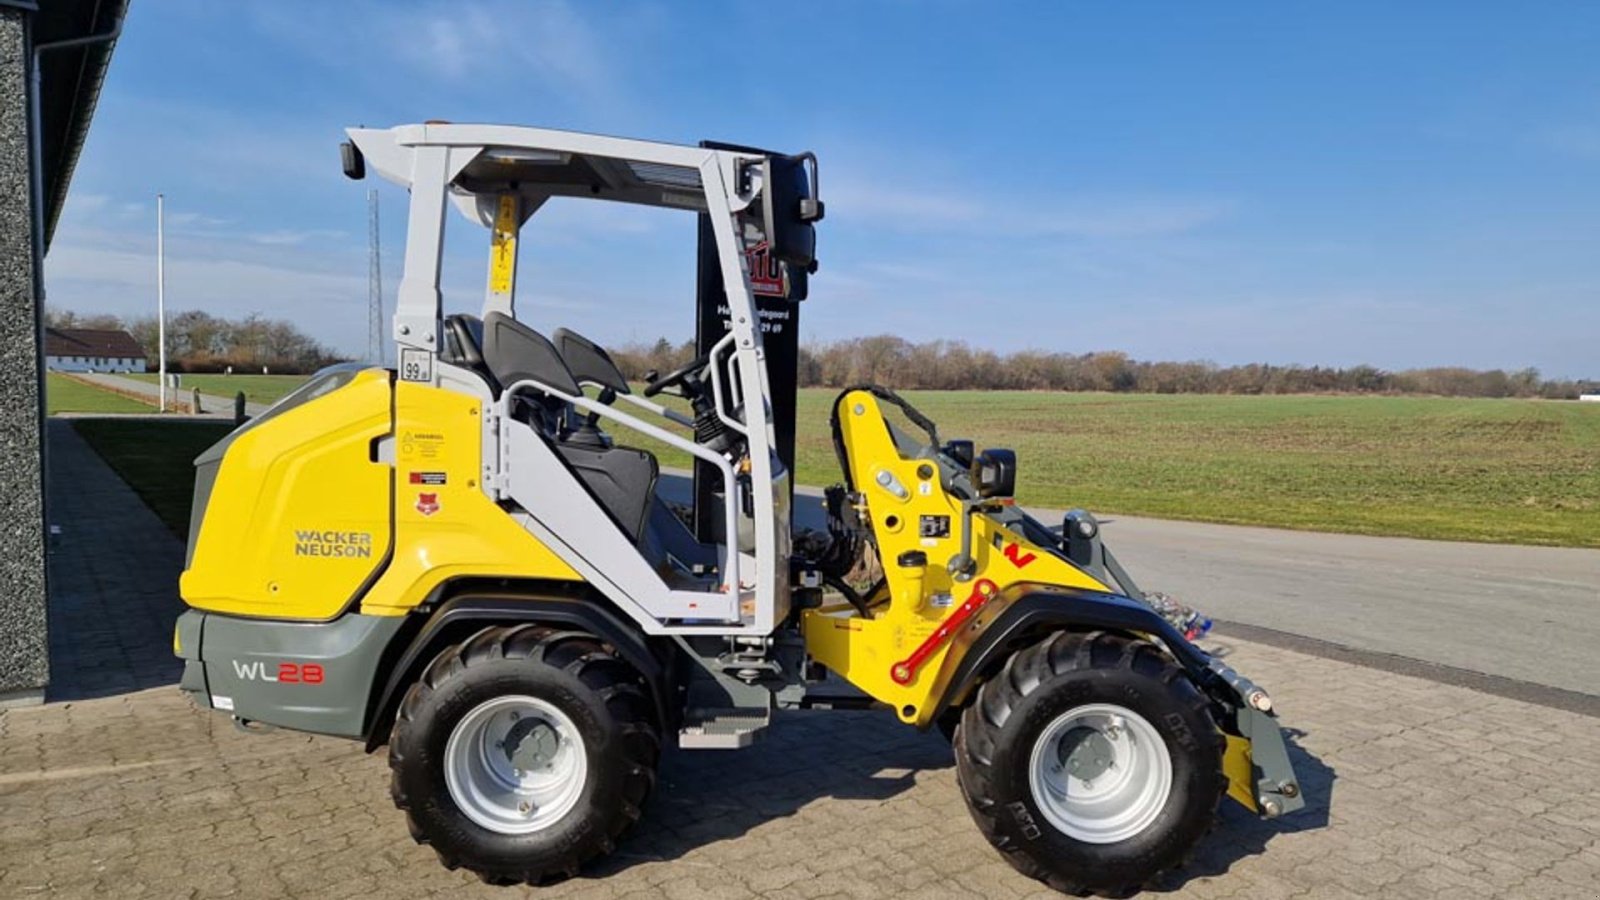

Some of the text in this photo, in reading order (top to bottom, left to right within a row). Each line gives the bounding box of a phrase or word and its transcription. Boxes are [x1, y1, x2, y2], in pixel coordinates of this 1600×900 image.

[405, 362, 419, 379] 99
[295, 530, 371, 545] WACKER
[295, 543, 371, 558] NEUSON
[232, 660, 325, 684] WL28
